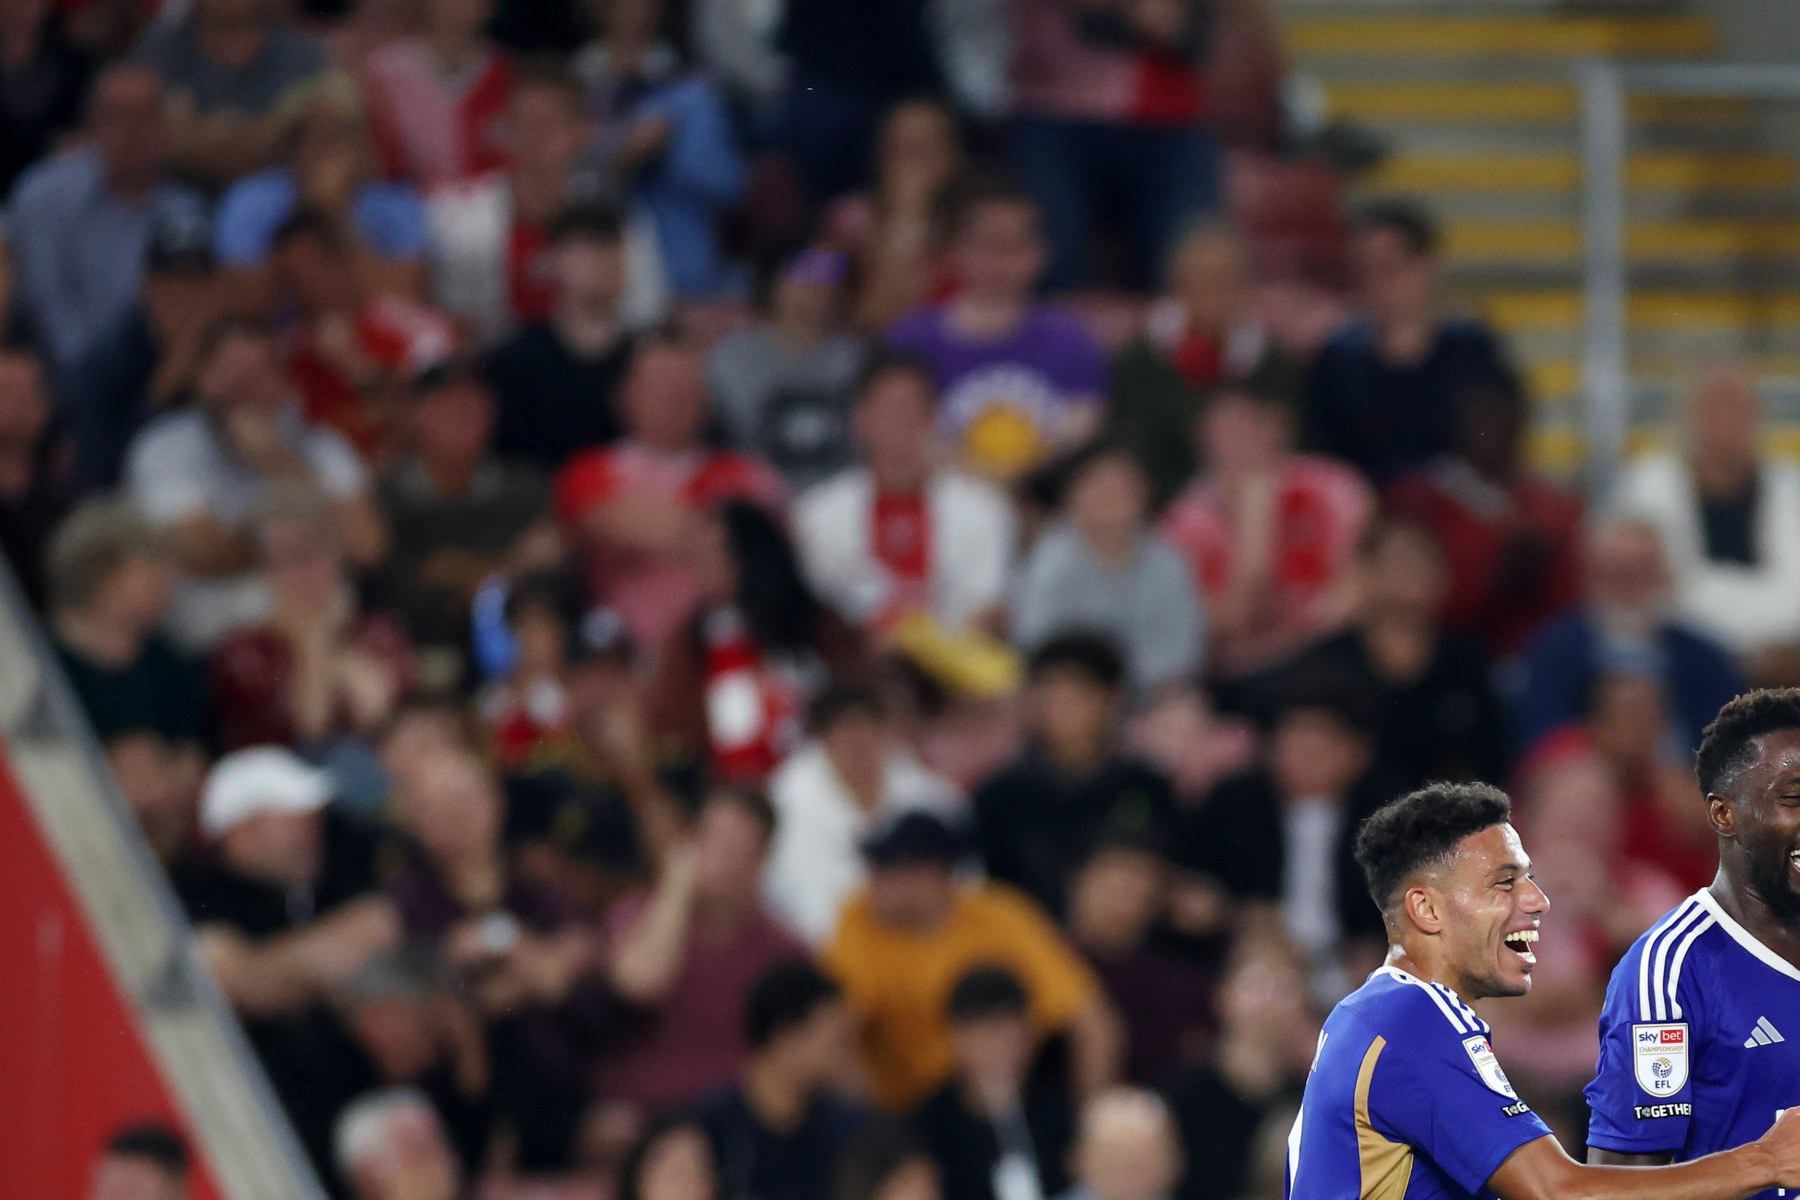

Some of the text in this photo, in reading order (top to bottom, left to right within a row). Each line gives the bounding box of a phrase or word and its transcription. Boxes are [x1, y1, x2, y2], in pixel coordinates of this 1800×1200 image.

[1638, 1031, 1682, 1043] sky bet
[1471, 1043, 1486, 1054] sky
[1655, 1081, 1671, 1089] EFL
